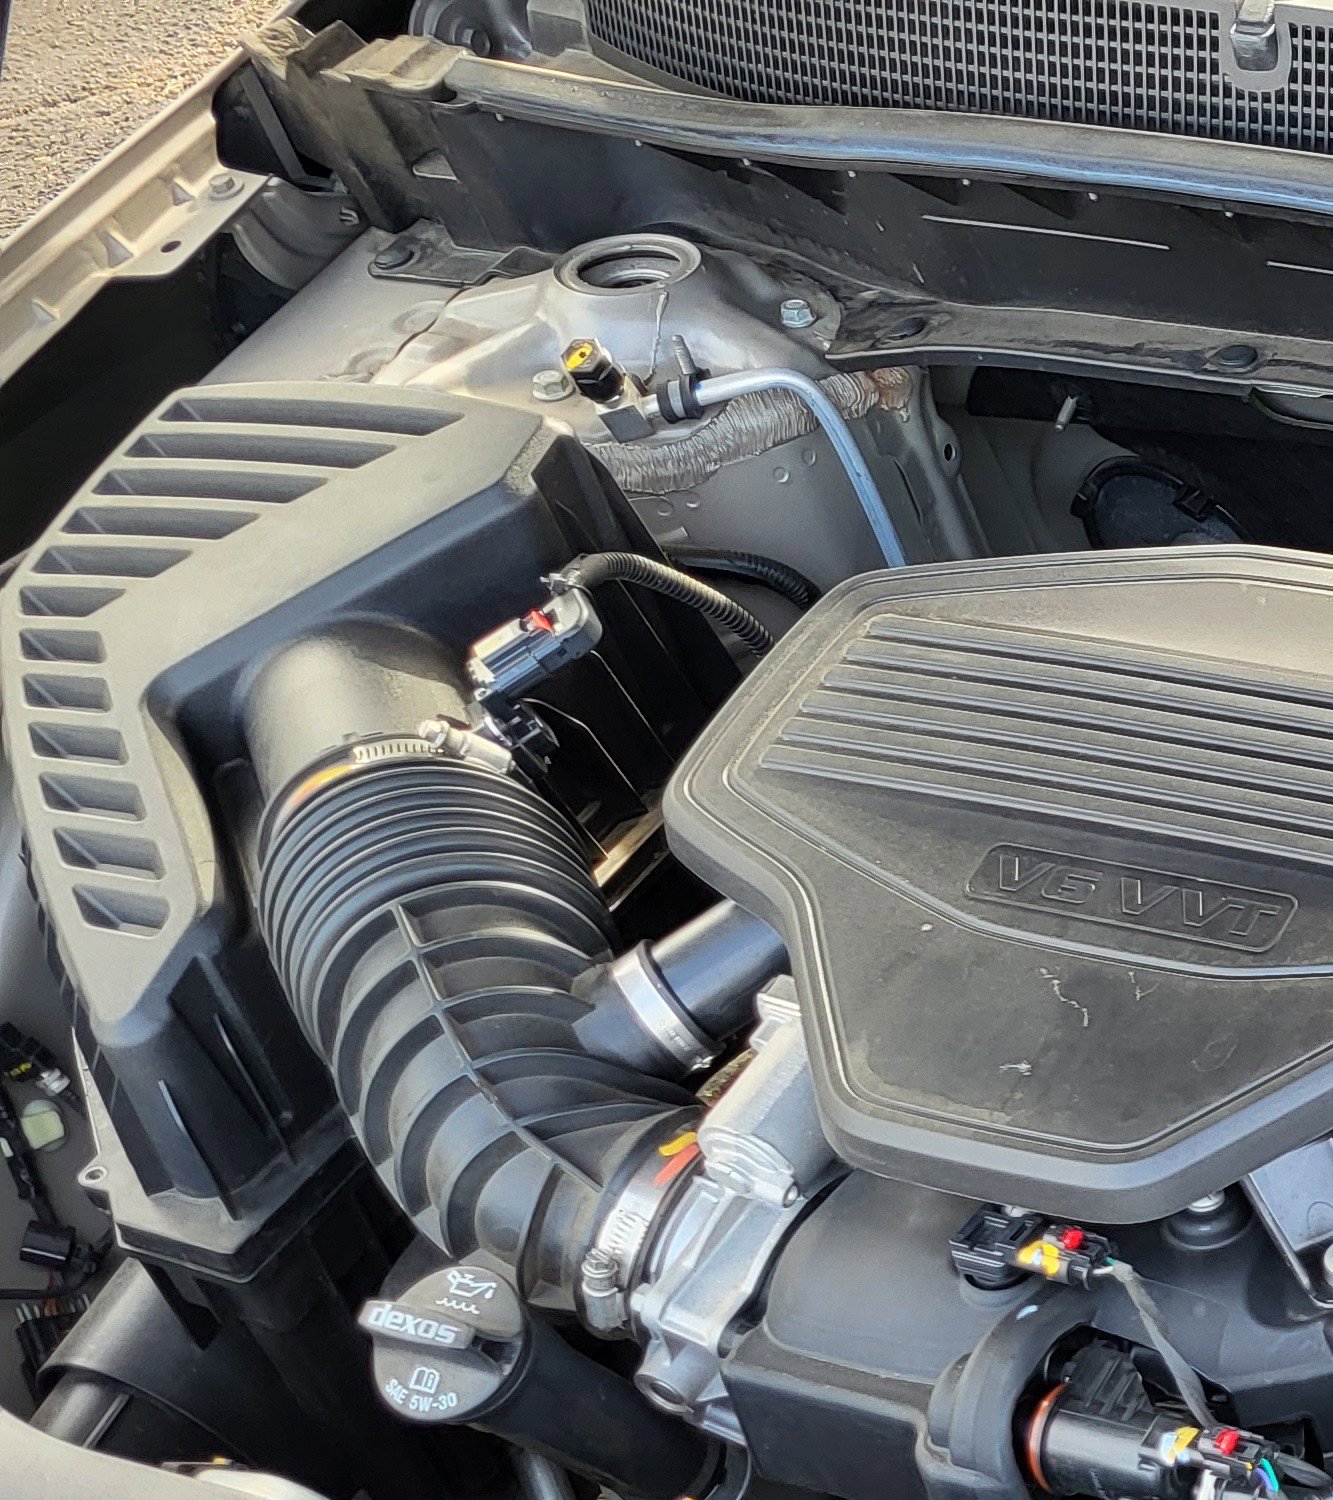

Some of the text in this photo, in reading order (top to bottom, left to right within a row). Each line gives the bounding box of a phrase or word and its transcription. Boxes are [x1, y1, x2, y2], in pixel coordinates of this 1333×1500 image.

[998, 852, 1281, 937] V6 VVT
[368, 1304, 463, 1344] dexos
[385, 1377, 459, 1413] SAE 5W-30
